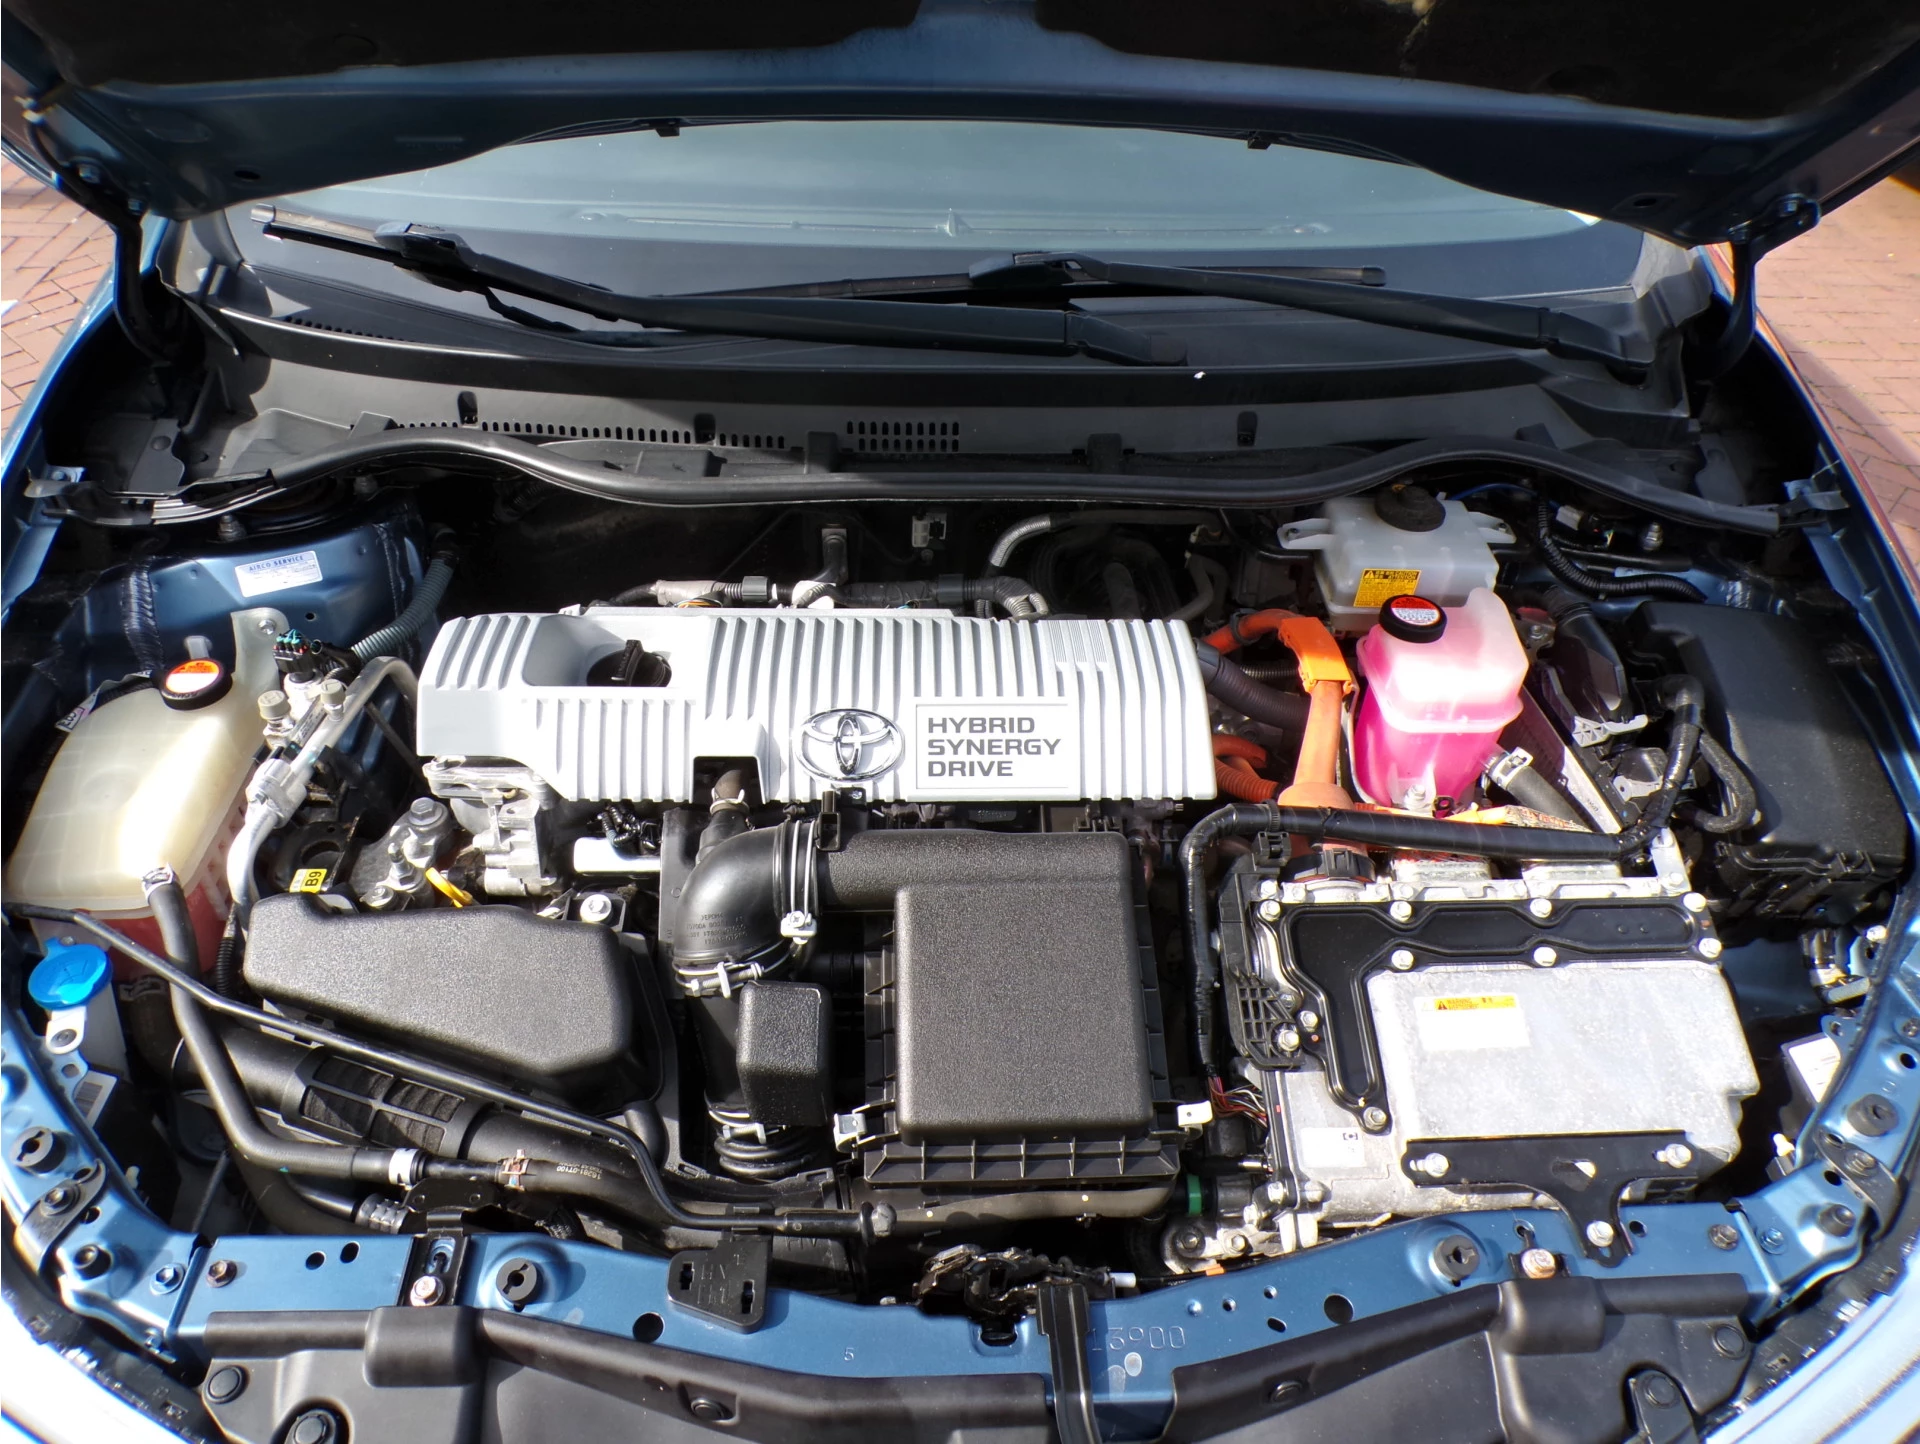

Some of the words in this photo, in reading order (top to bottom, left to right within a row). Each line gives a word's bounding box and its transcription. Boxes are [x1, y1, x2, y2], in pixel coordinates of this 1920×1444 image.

[249, 562, 271, 571] AIRCO
[273, 555, 304, 566] SERVICE
[928, 717, 1035, 734] HYBRID
[928, 738, 1061, 756] SYNERGY
[928, 760, 1014, 777] DRIVE
[305, 871, 321, 886] B9
[844, 1347, 855, 1361] 5
